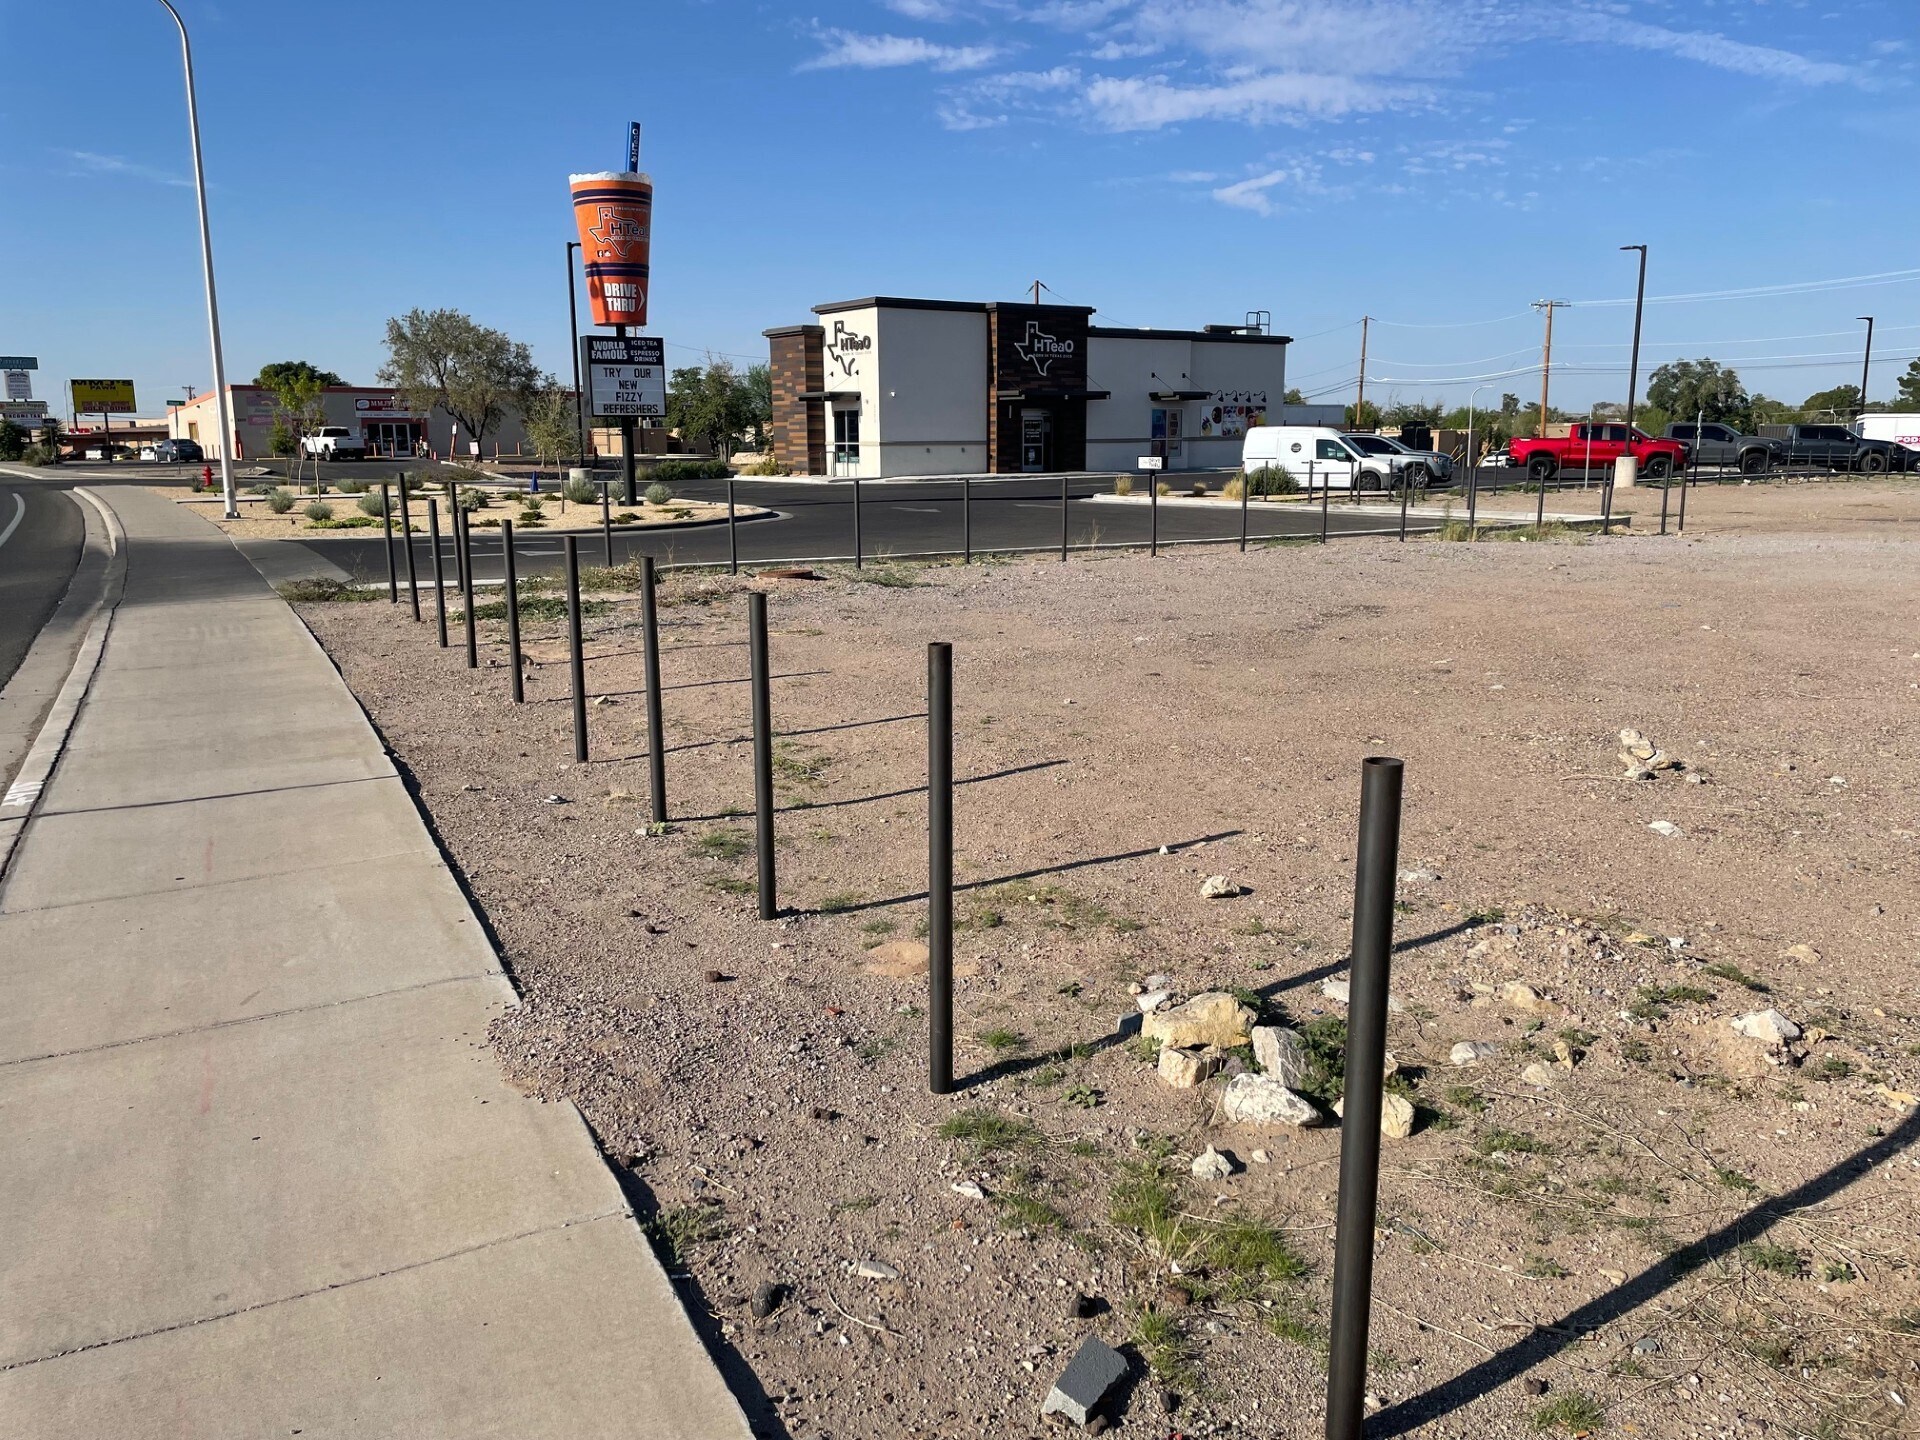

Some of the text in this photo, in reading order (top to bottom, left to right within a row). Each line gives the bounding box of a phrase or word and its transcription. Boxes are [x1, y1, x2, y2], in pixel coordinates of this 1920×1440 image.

[603, 282, 637, 298] DRIVE
[606, 297, 636, 312] THRU
[592, 341, 626, 350] WORLD
[840, 335, 871, 352] HTeaO
[1034, 338, 1074, 353] HTeaO
[591, 350, 628, 360] FAMOUS
[603, 367, 651, 378] TRY OUR
[618, 380, 638, 390] NEW
[615, 392, 643, 402] FIZZY
[603, 404, 659, 414] REFRESHERS
